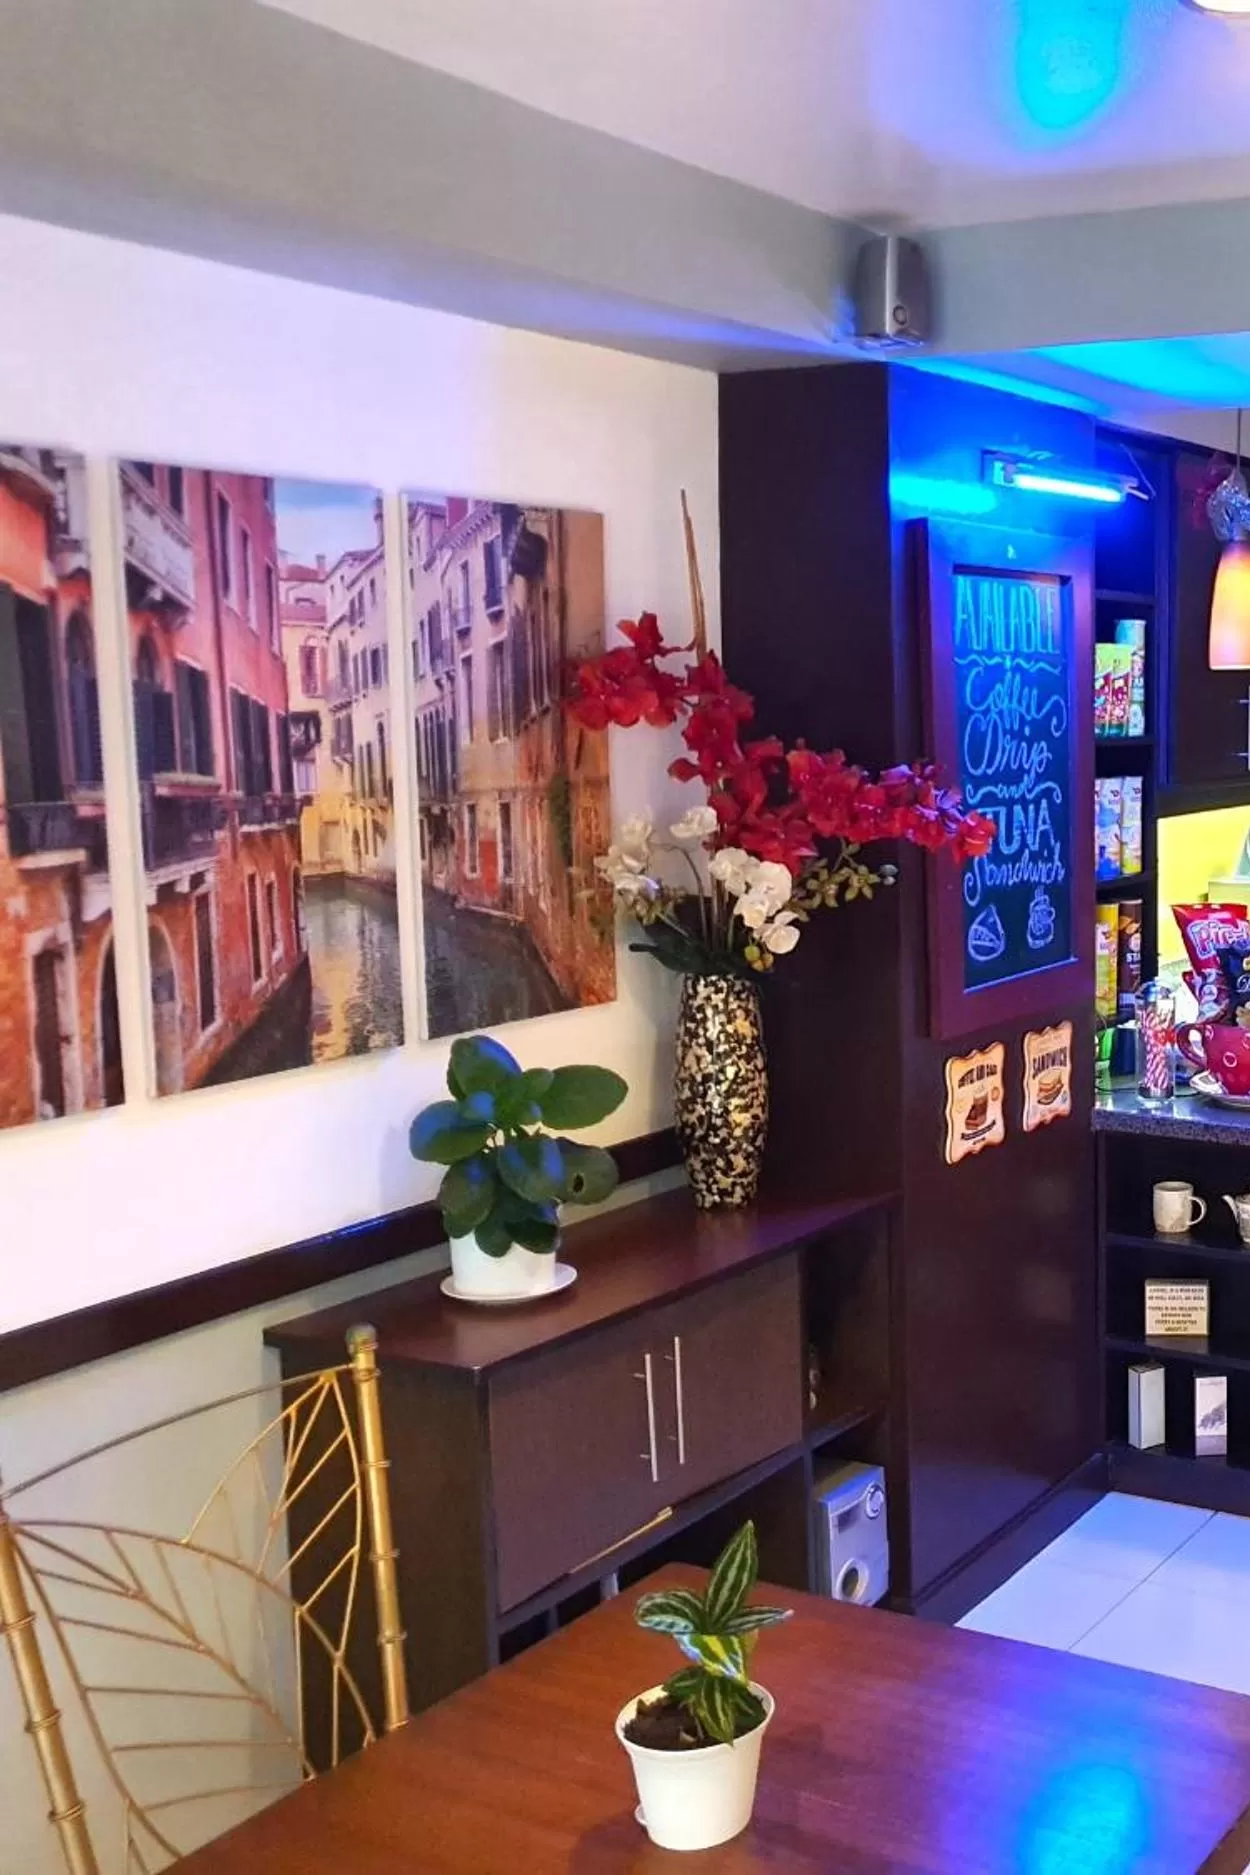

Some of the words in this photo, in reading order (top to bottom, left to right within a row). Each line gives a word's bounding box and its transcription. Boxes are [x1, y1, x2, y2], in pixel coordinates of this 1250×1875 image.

[966, 667, 1066, 737] Coffee
[964, 713, 1053, 786] Drip
[977, 799, 1056, 854] TUNA
